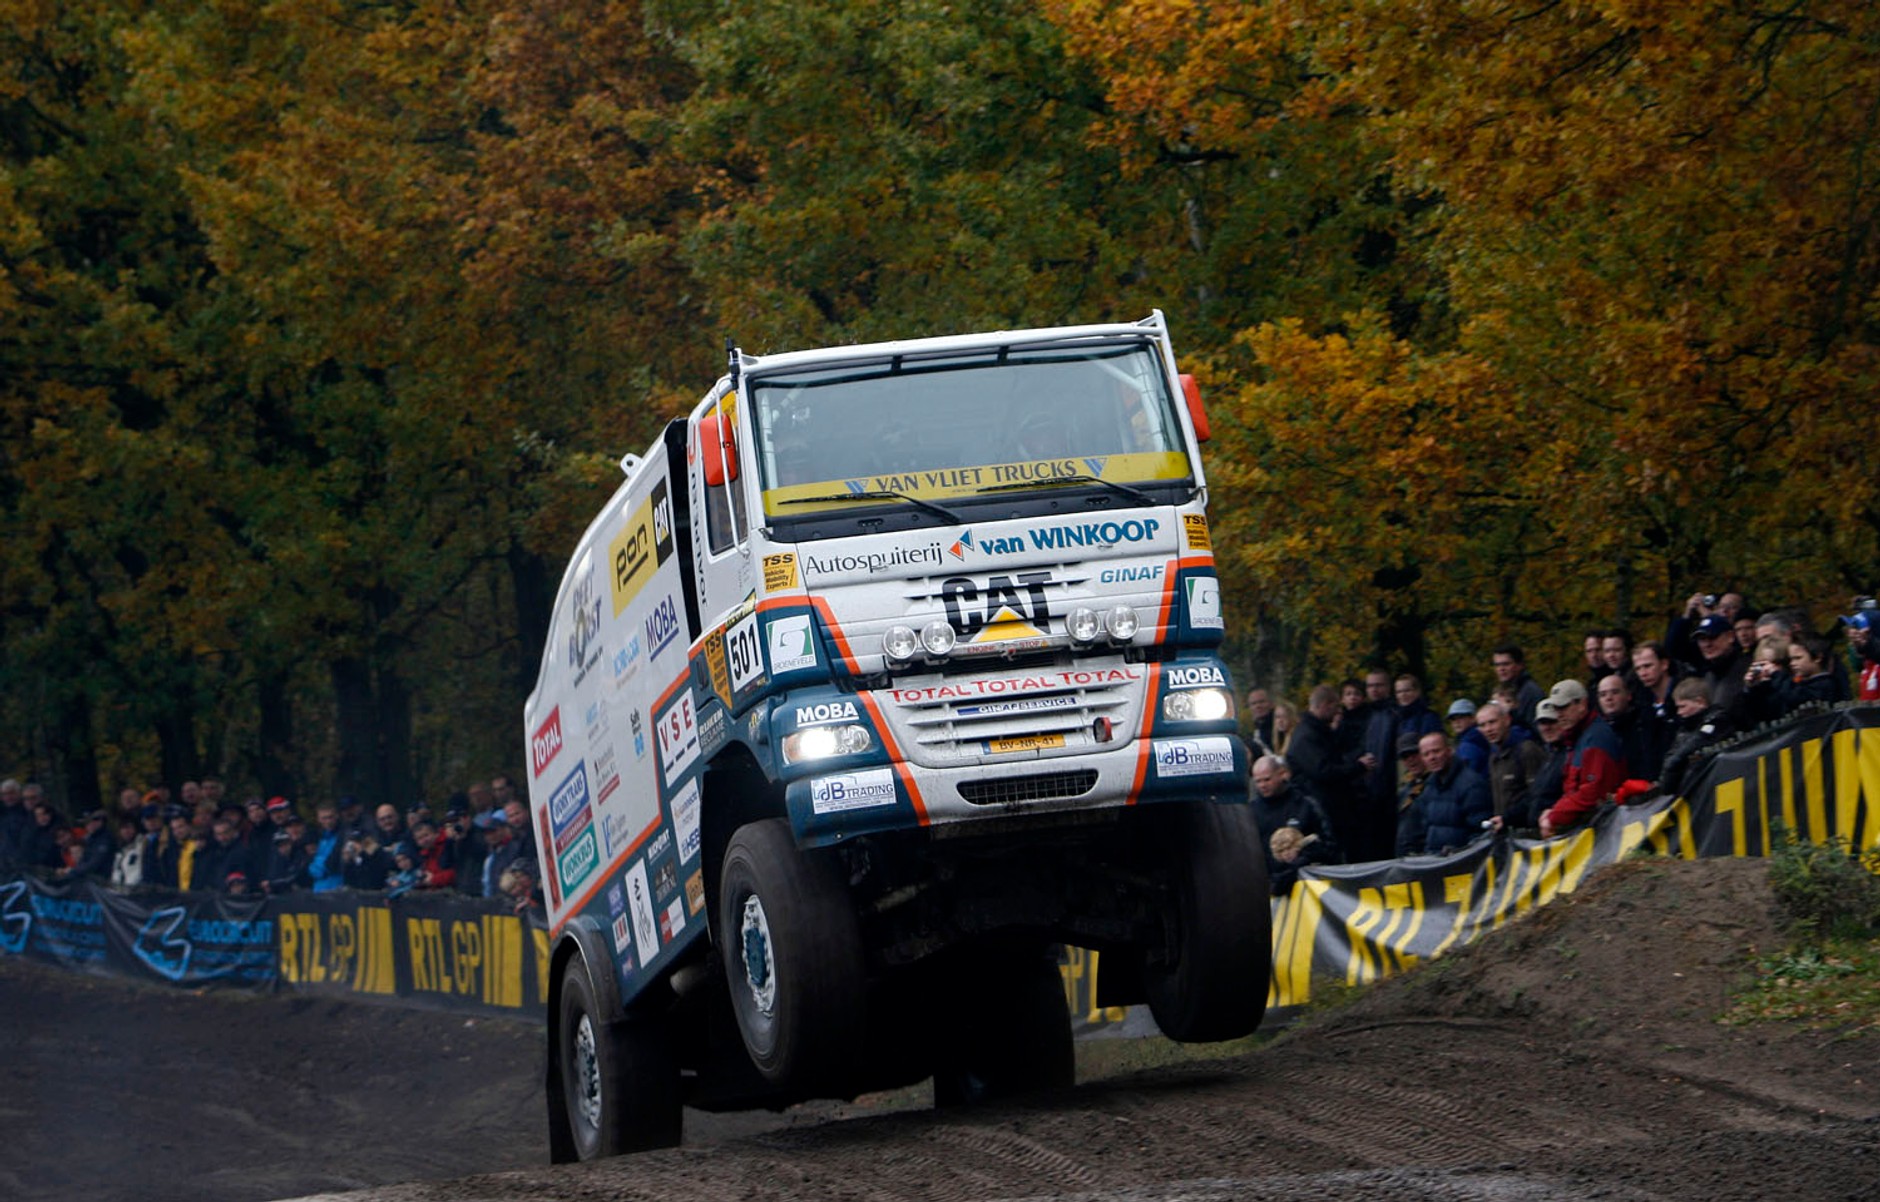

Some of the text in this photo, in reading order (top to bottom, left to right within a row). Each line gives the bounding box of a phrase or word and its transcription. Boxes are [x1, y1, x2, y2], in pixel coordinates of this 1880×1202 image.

[875, 460, 1077, 493] VAN VLIET TRUCKS
[653, 497, 670, 547] CAT
[805, 518, 1160, 576] Autospuiterij van WINKOOP
[616, 523, 648, 593] pon
[763, 553, 793, 567] TSS
[1100, 565, 1164, 584] GINAF
[645, 593, 678, 653] MOBA
[941, 571, 1054, 643] CAT
[729, 622, 760, 681] 501
[1168, 667, 1224, 686] MOBA
[886, 668, 1141, 704] TOTAL TOTAL TOTAL
[660, 699, 692, 753] VSE
[796, 702, 858, 724] MOBA
[533, 721, 562, 771] TOTAL
[999, 737, 1056, 751] BV-NR-41
[1189, 752, 1233, 764] TRADING
[846, 784, 894, 799] TRADING
[279, 913, 326, 984] RTL
[408, 918, 452, 993] RTL
[453, 921, 481, 995] GP
